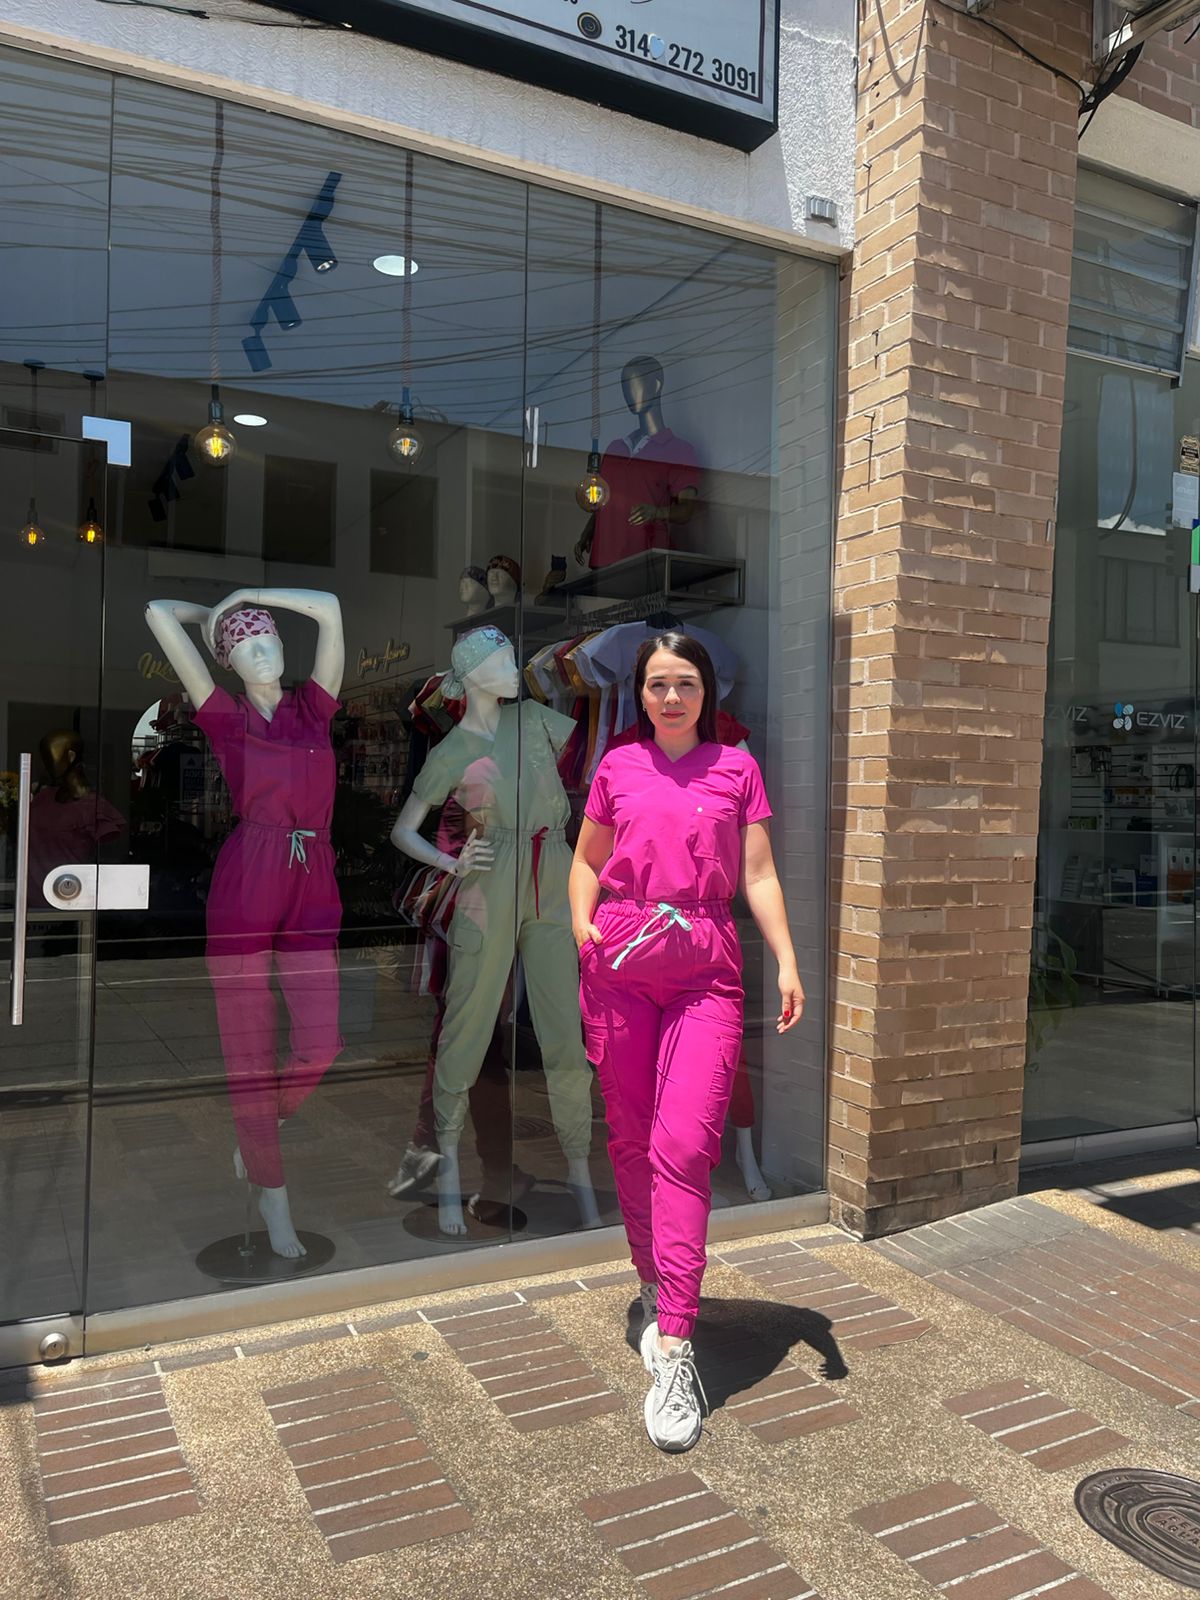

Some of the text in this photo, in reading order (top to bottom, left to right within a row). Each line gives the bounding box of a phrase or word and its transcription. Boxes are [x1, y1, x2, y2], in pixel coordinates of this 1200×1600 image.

[615, 24, 756, 94] 314 272 3091
[1047, 704, 1088, 722] ZVIZ
[1136, 711, 1186, 729] EZVIZ
[1155, 1519, 1200, 1547] AGUA
